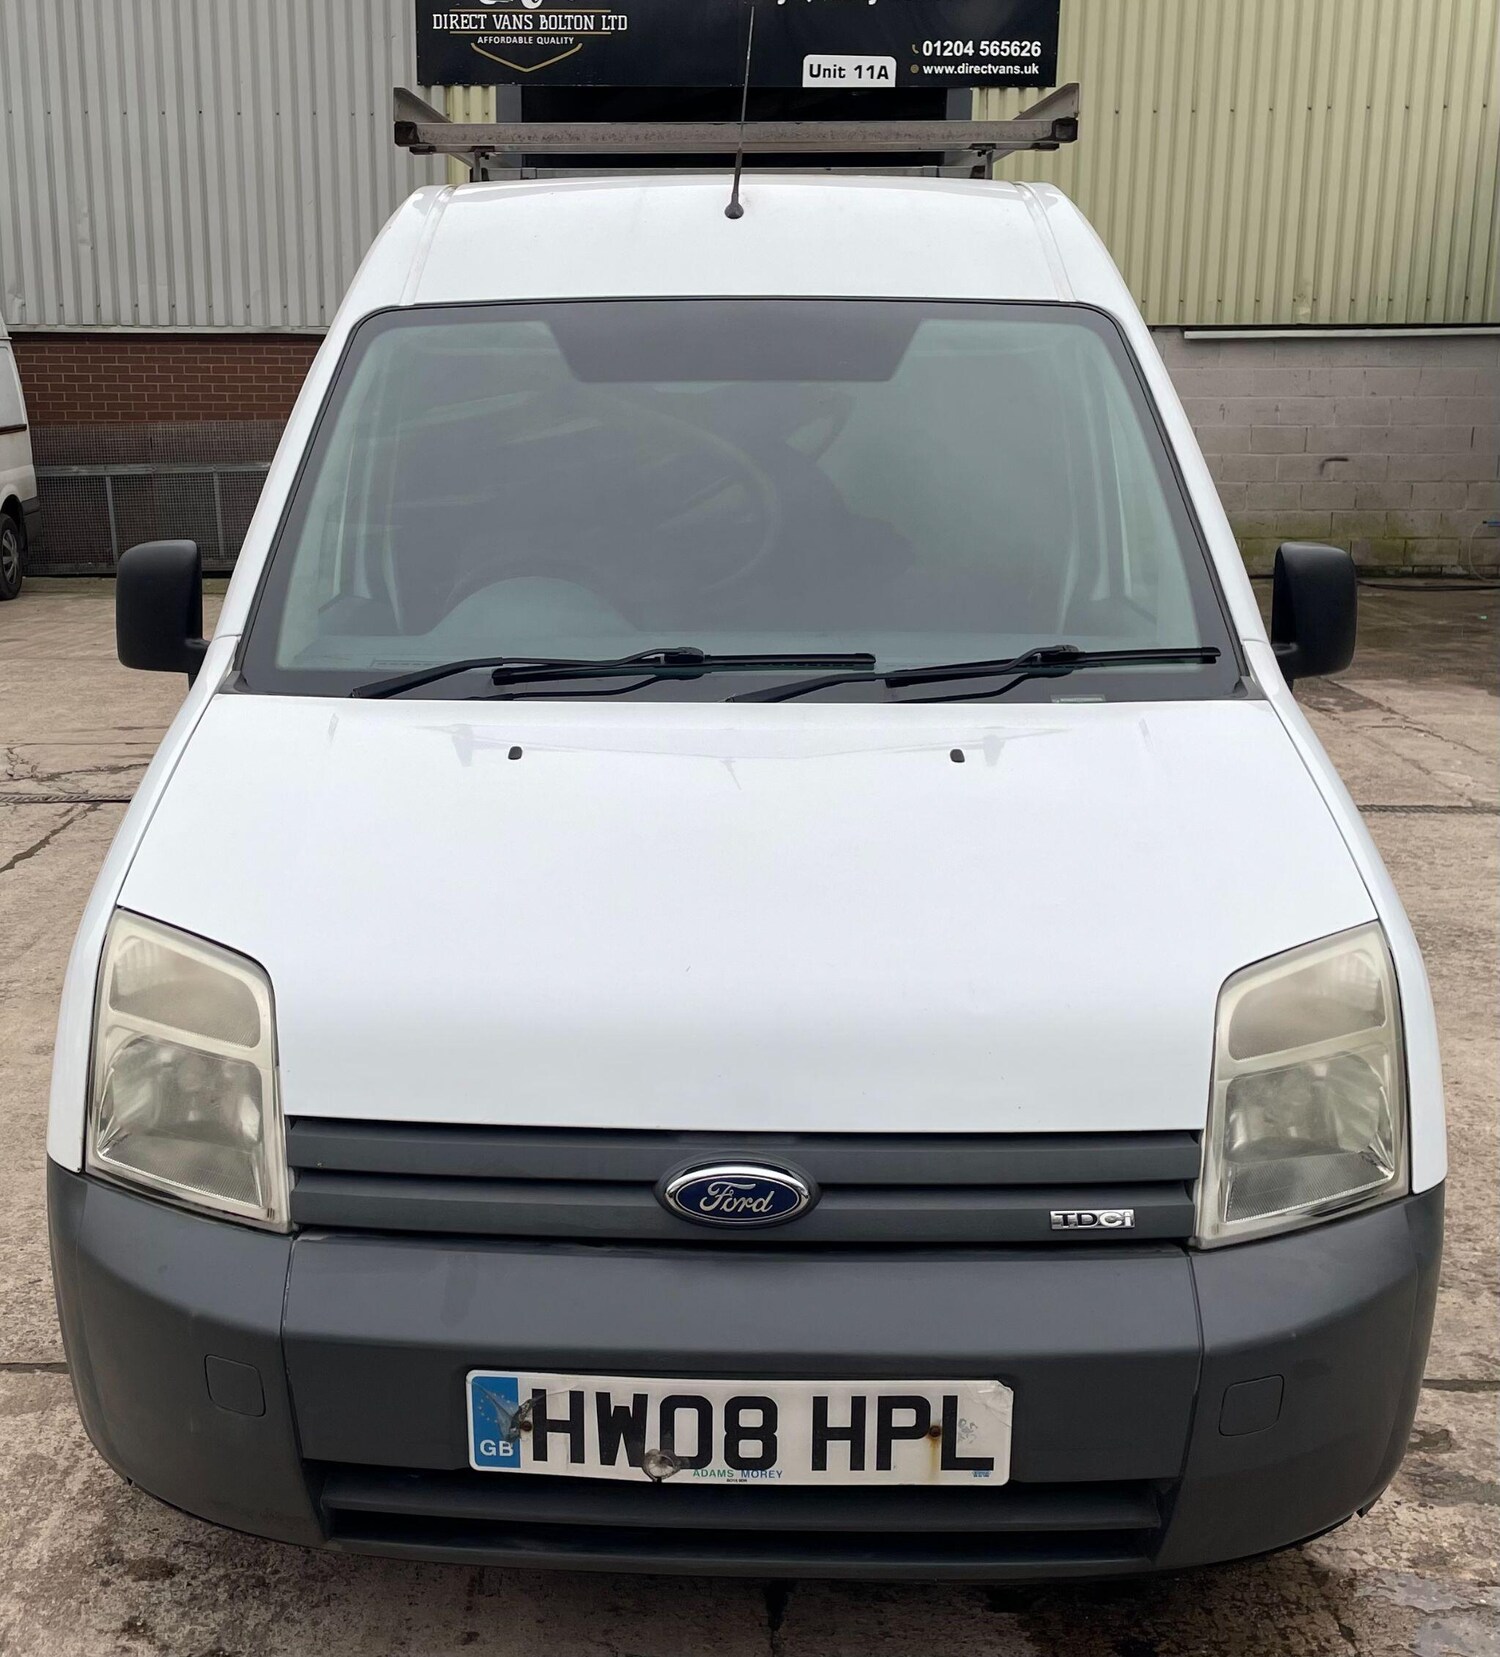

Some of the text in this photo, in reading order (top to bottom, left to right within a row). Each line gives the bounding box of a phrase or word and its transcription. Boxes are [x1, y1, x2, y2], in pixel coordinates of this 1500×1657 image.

[432, 13, 628, 31] DIRECT VANS BOLTON LTD
[477, 36, 574, 45] AFFORDABLE QUALITY
[922, 40, 1042, 57] 01204 565626
[809, 63, 889, 80] Unit 11A
[922, 62, 1039, 75] www.directvans.uk
[699, 1181, 775, 1213] Ford
[1052, 1210, 1133, 1228] TDCi
[531, 1388, 995, 1471] HW08 HPL
[479, 1439, 514, 1457] GB
[692, 1469, 783, 1478] ADAMS MOREY
